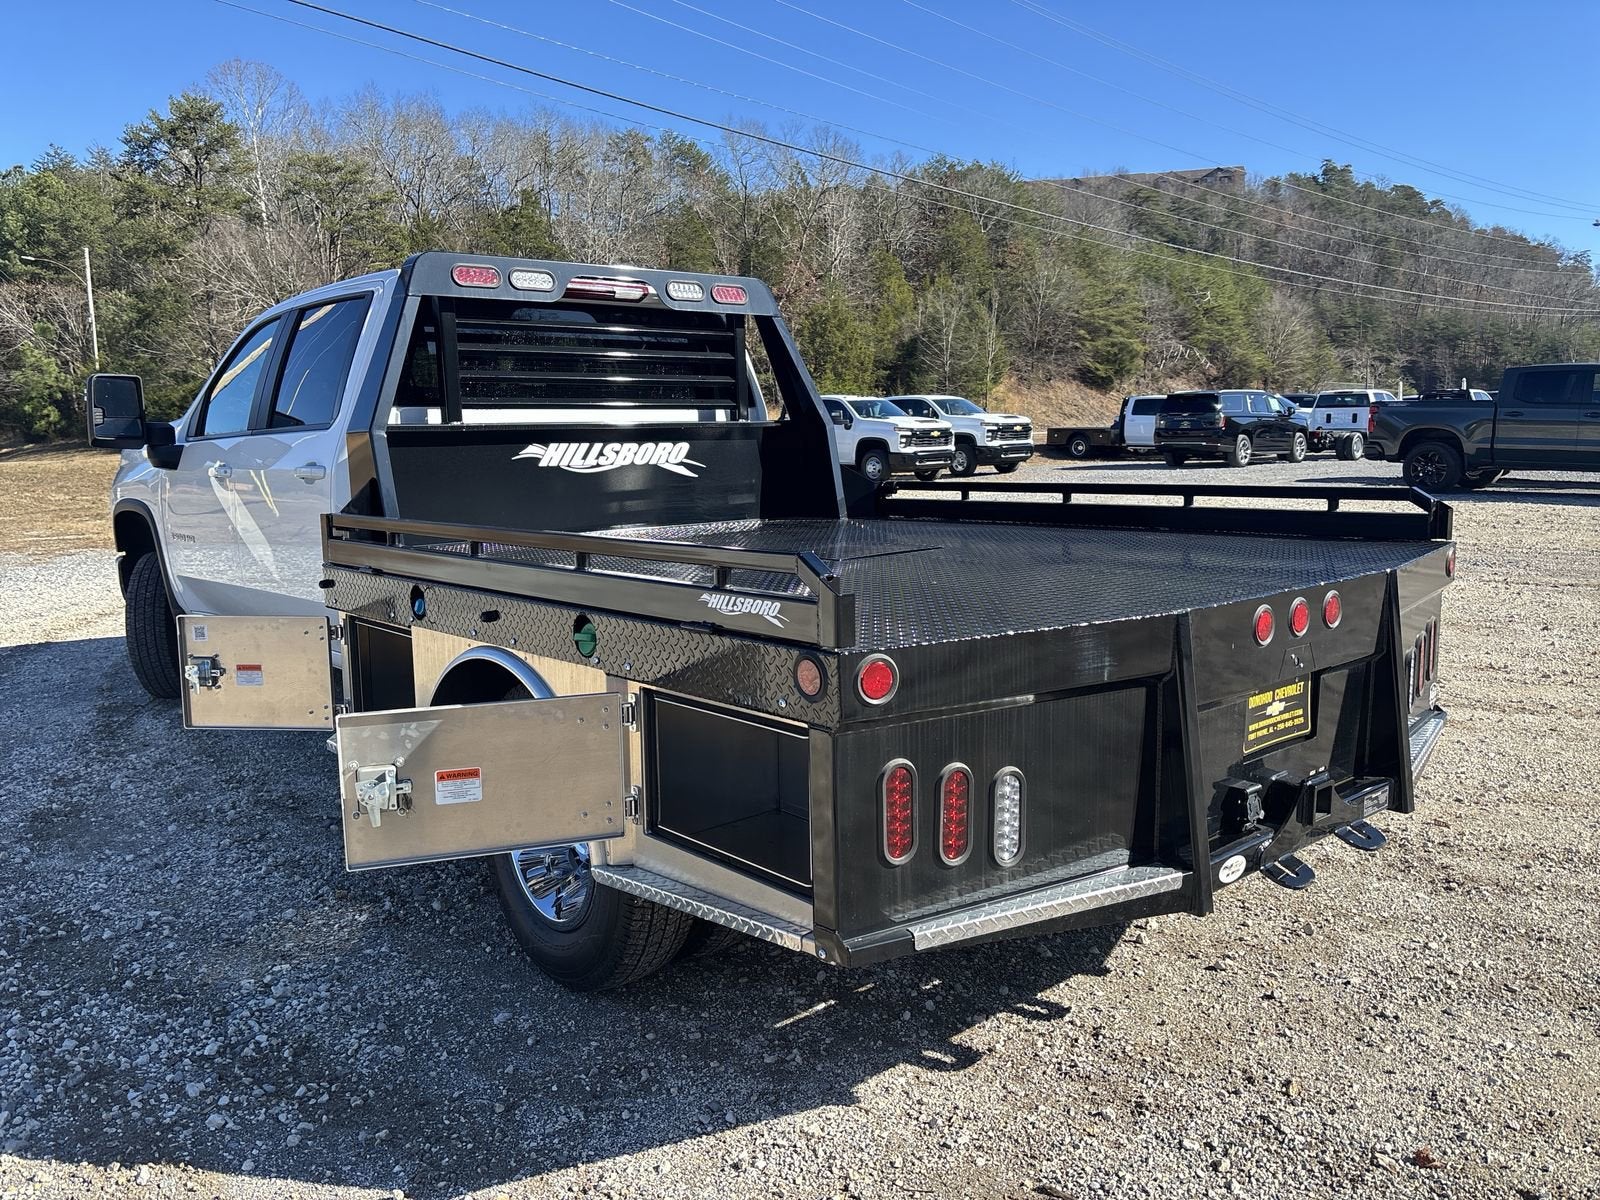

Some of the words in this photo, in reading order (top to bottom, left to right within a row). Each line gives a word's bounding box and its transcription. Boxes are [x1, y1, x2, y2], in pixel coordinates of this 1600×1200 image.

[538, 442, 690, 467] HILLSBORO
[708, 594, 781, 616] HILLSBORO
[1275, 682, 1304, 700] CHEVROLET
